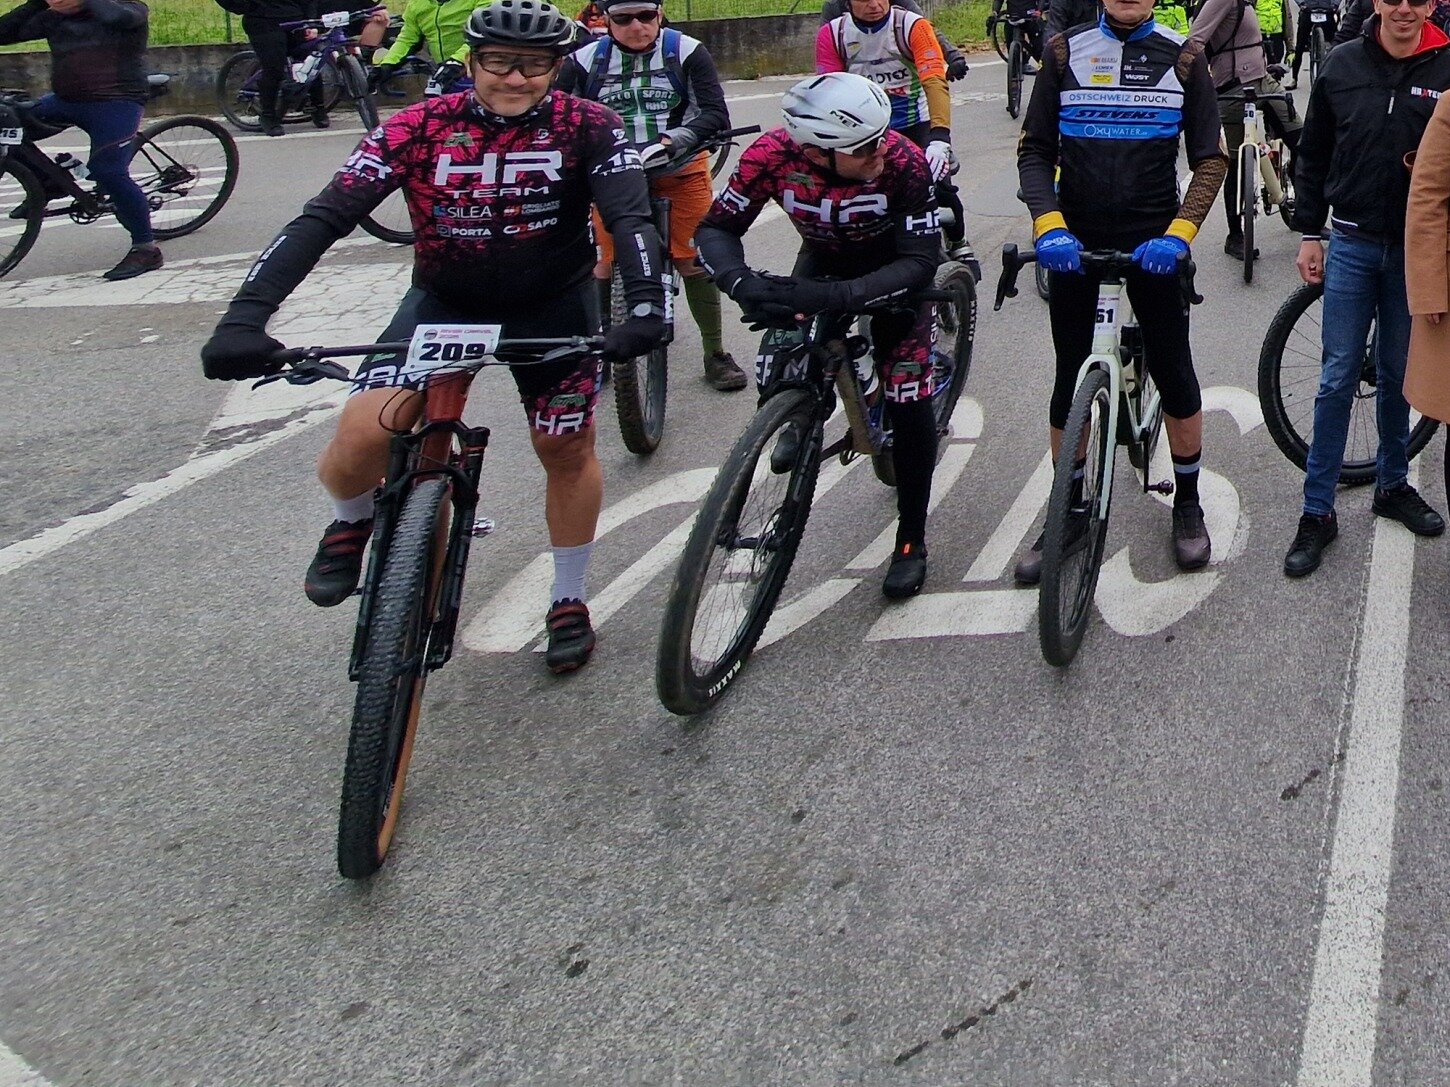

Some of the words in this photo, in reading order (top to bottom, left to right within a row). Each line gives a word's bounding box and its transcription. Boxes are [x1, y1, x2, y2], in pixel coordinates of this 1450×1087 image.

[642, 89, 675, 100] SPORT
[1069, 93, 1131, 102] OSTSCHWEIZ
[1133, 94, 1168, 104] DRUCK
[829, 110, 861, 129] MET
[1074, 109, 1161, 119] STEVENS
[434, 151, 564, 186] HR
[445, 186, 549, 199] TEAM
[447, 205, 493, 219] SILEA
[783, 189, 888, 224] HR
[452, 227, 492, 236] PORTA
[419, 342, 486, 361] 209
[884, 381, 919, 403] HR
[535, 410, 584, 436] HR
[708, 659, 741, 698] MAXXIS
